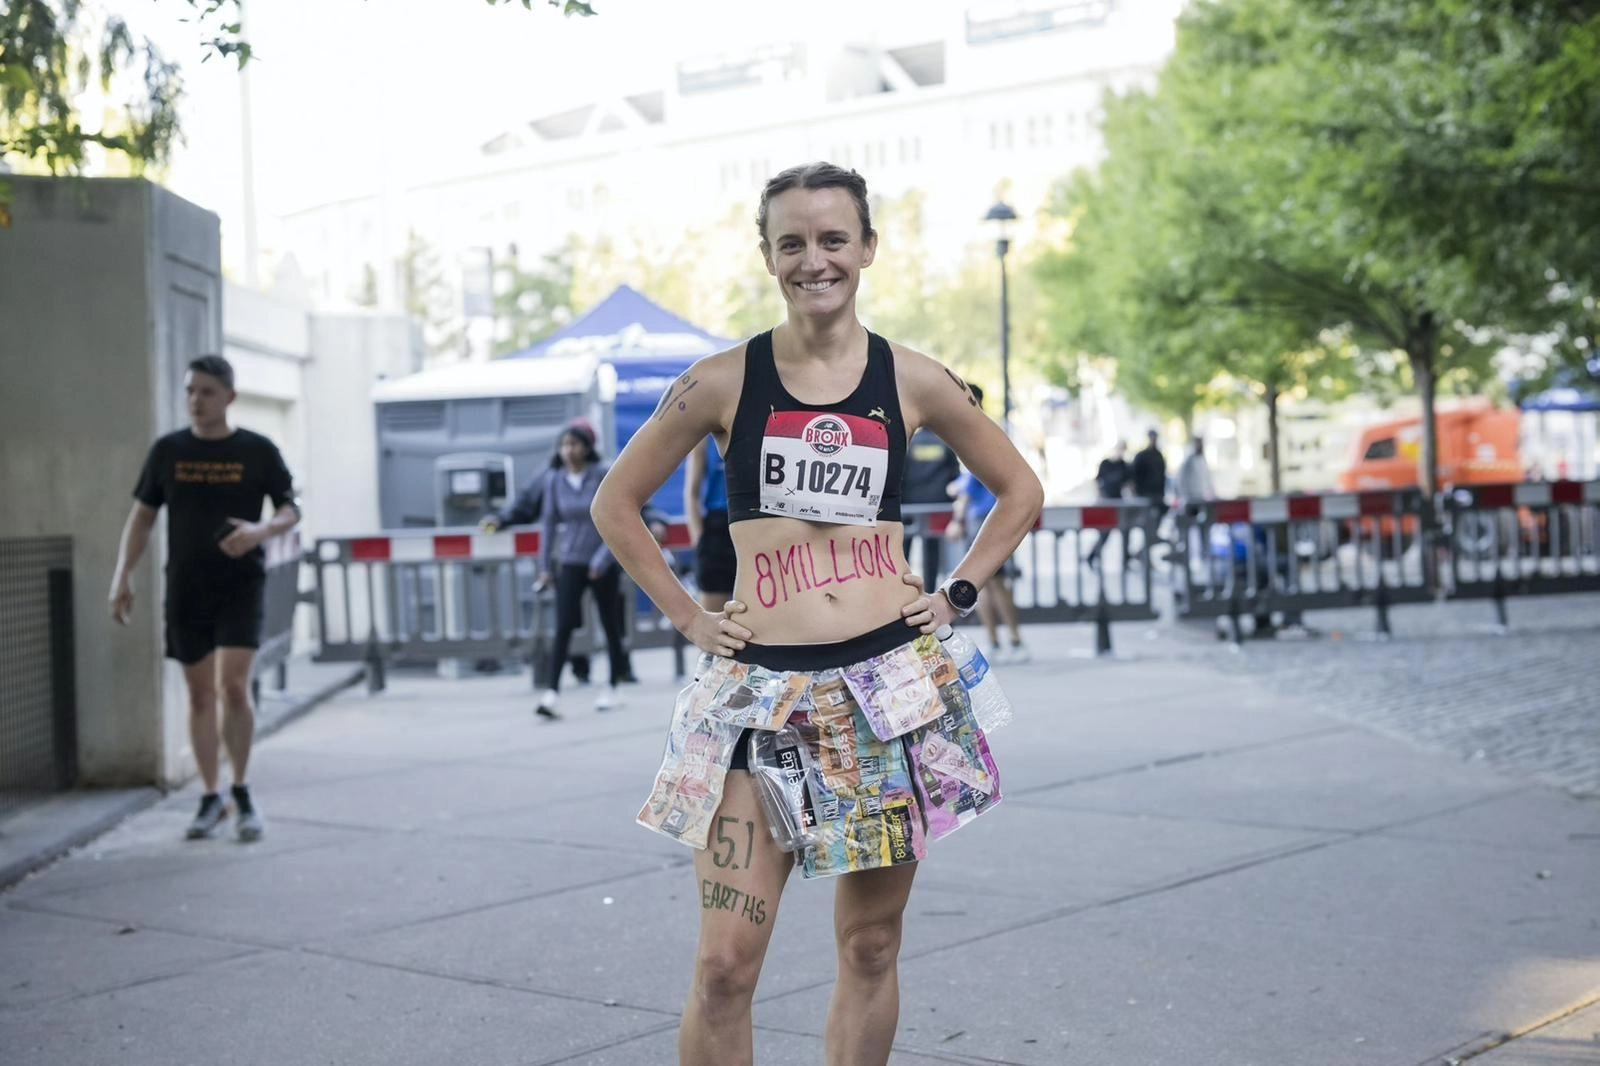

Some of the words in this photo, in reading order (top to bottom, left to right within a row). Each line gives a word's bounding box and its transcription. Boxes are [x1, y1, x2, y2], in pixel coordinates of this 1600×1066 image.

[805, 428, 850, 447] BRONX
[765, 452, 785, 485] B
[796, 459, 872, 498] 10274
[838, 722, 854, 769] easy
[780, 751, 805, 808] essentia
[713, 816, 754, 870] 5.1
[891, 814, 906, 848] STINGER
[702, 878, 766, 925] EARTHS
